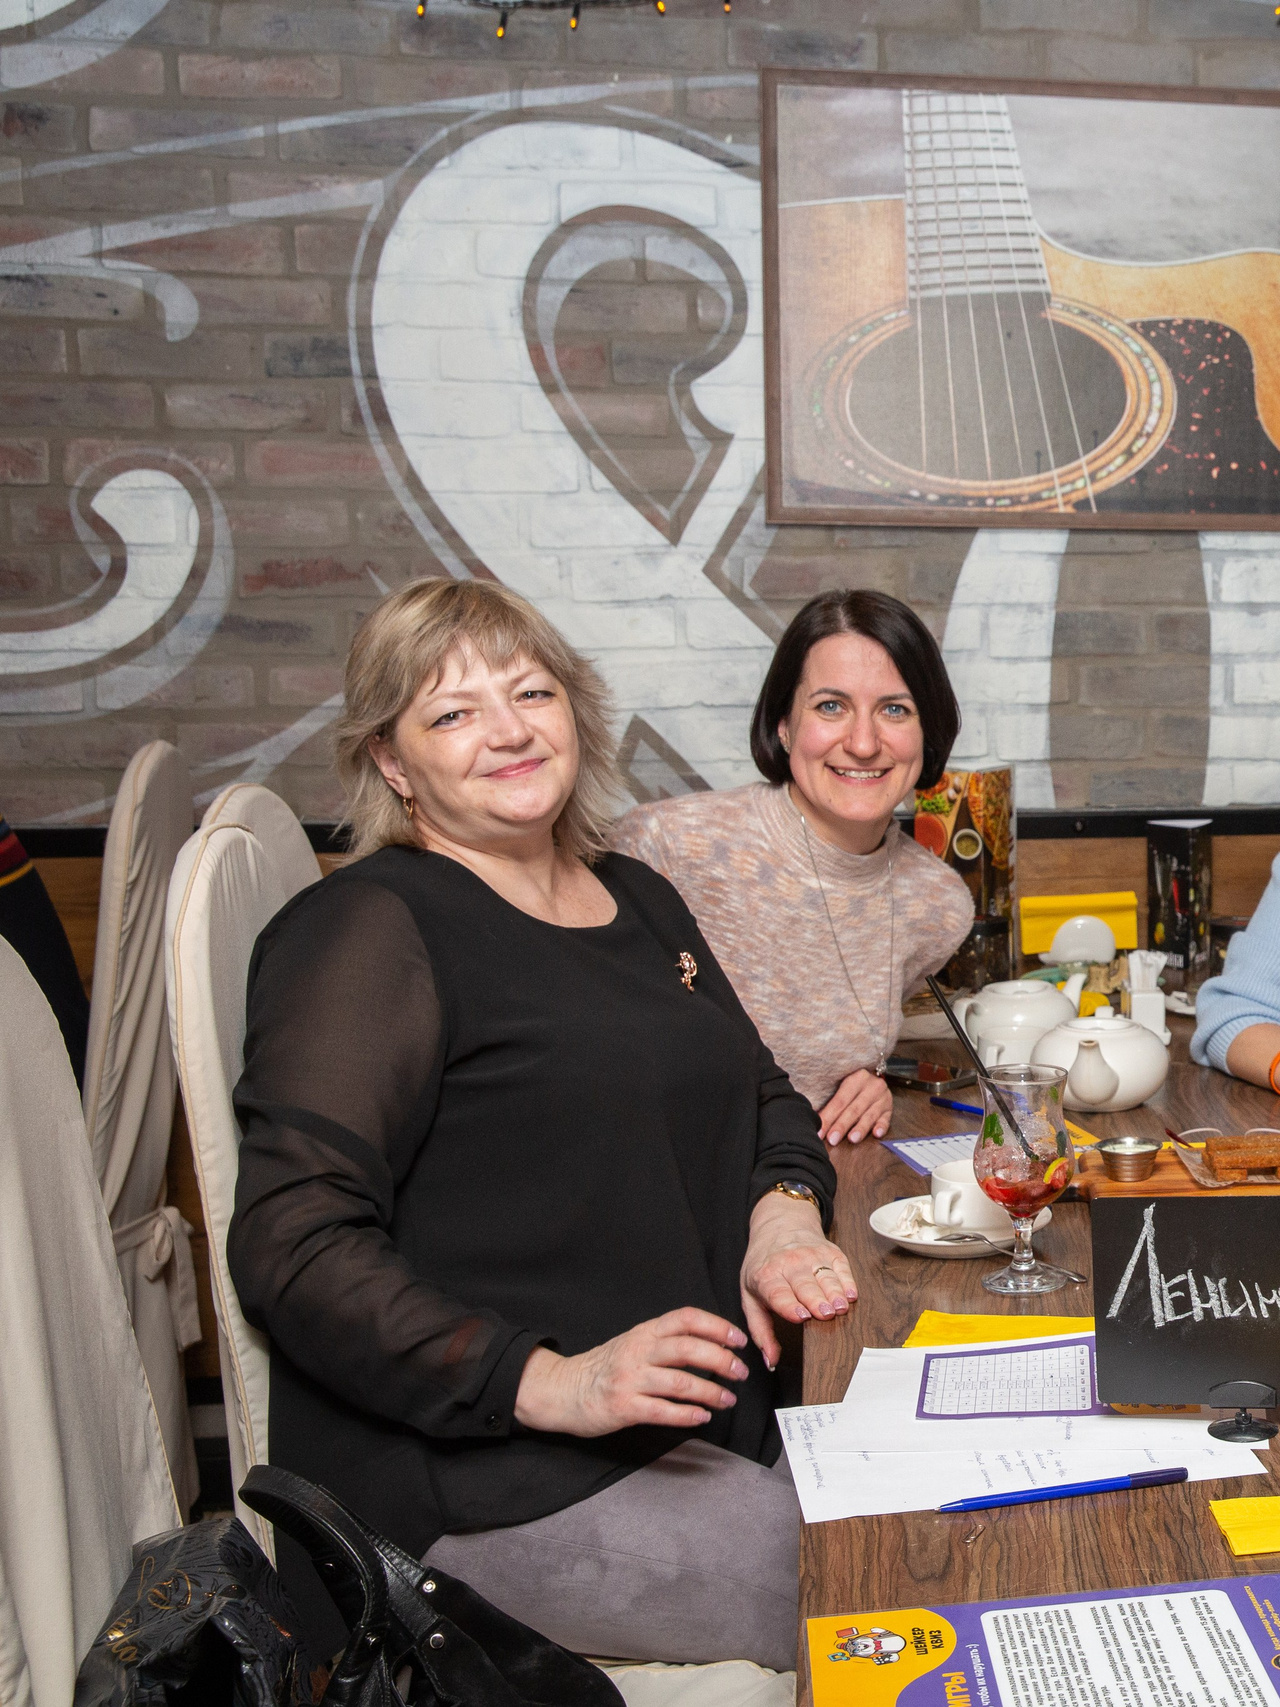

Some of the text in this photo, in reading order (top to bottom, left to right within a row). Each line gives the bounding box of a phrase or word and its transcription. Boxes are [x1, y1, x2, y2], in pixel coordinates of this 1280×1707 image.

[912, 1627, 928, 1656] ШЕЙКЕР
[930, 1629, 944, 1650] КВИЗ
[971, 1650, 986, 1677] нарушать
[975, 1677, 986, 1690] их
[976, 1691, 991, 1706] чтобы
